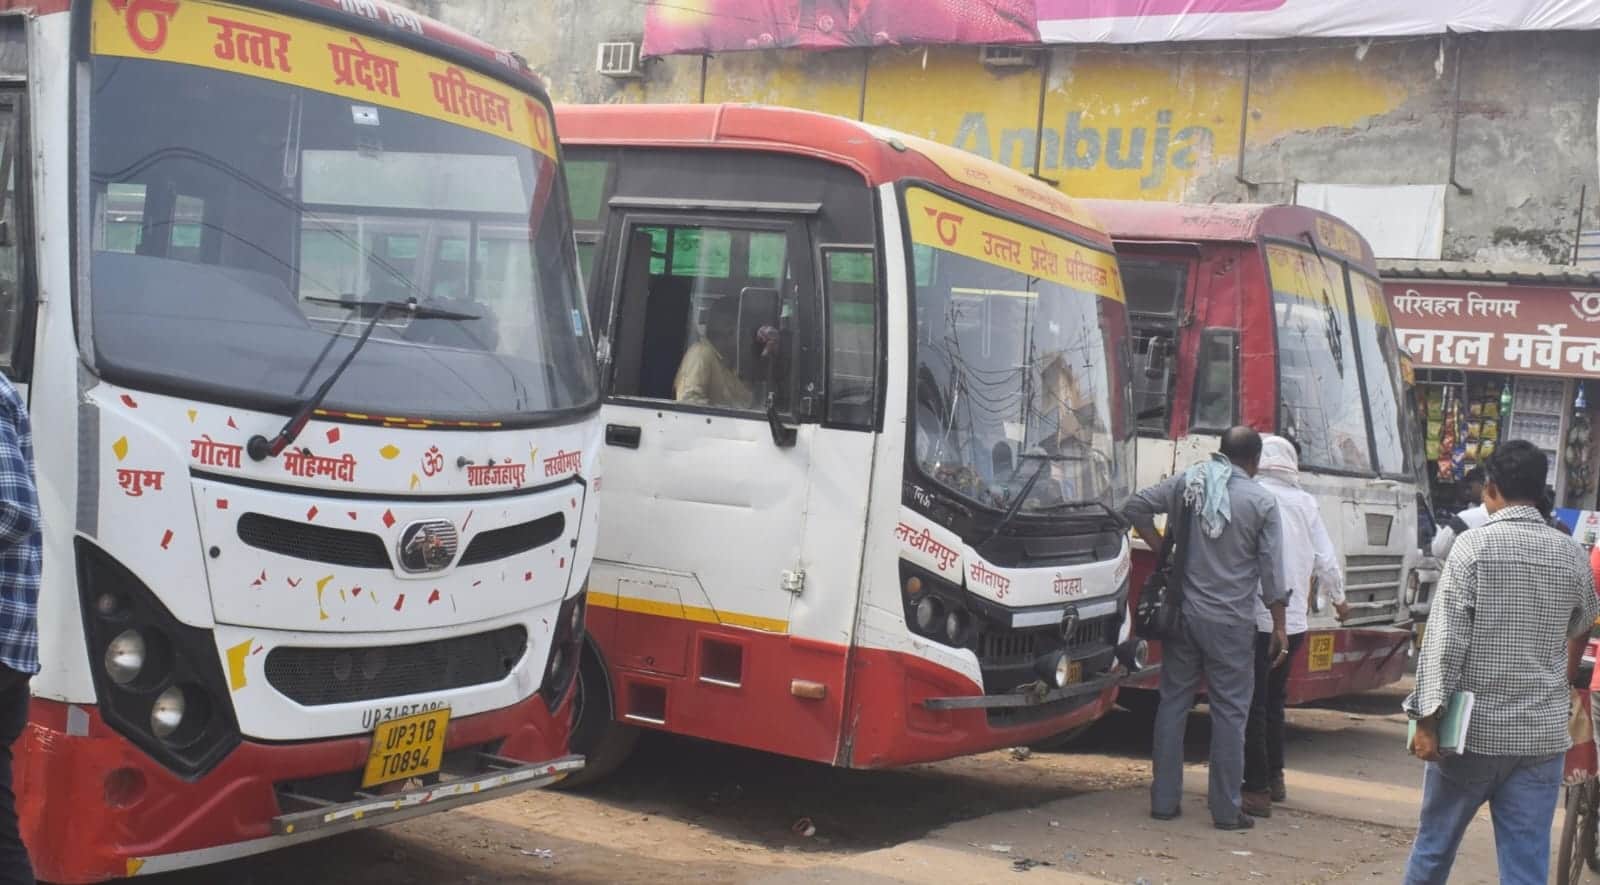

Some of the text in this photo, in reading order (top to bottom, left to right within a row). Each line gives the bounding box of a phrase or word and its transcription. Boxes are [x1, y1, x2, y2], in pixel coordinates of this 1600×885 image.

[207, 16, 513, 132] उत्तर प्रदेश परिवहन
[951, 110, 1217, 190] Ambuja
[981, 230, 1107, 288] उत्तर प्रदेश परिवहन
[1393, 289, 1520, 318] परिवहन निगम
[190, 434, 243, 469] गोला
[283, 446, 358, 483] मोहम्मदी
[543, 449, 582, 478] लखीमपुर
[895, 520, 960, 572] लखीमपुर
[970, 561, 1010, 600] सीतापुर
[386, 719, 437, 750] UP31B
[381, 746, 432, 777] T0894
